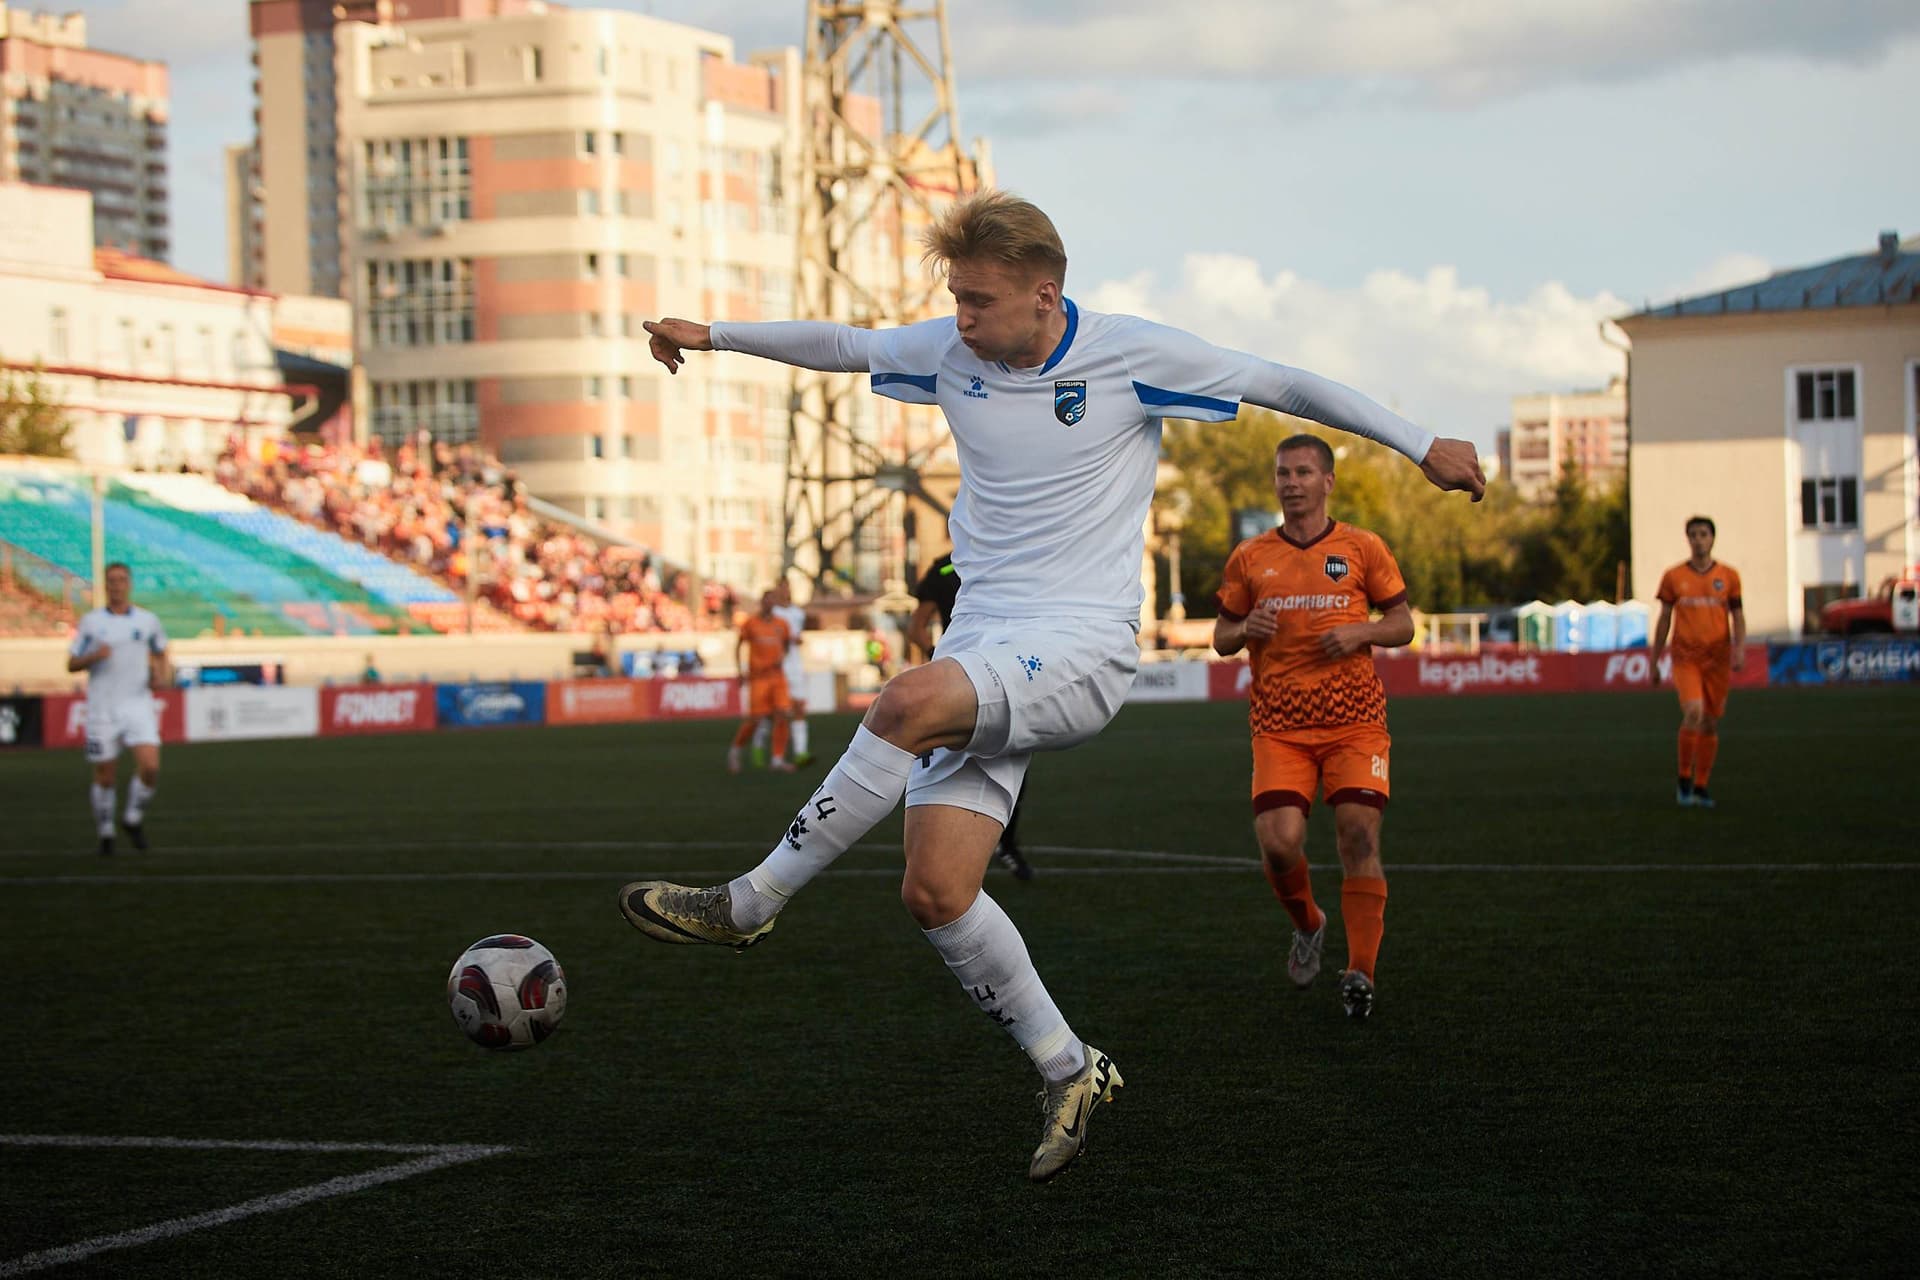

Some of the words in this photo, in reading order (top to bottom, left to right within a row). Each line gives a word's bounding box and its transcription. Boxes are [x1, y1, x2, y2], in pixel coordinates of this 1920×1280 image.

[963, 390, 989, 399] KELME
[984, 662, 1000, 688] KELME
[1016, 655, 1034, 682] KELME
[1419, 655, 1540, 692] legalbet
